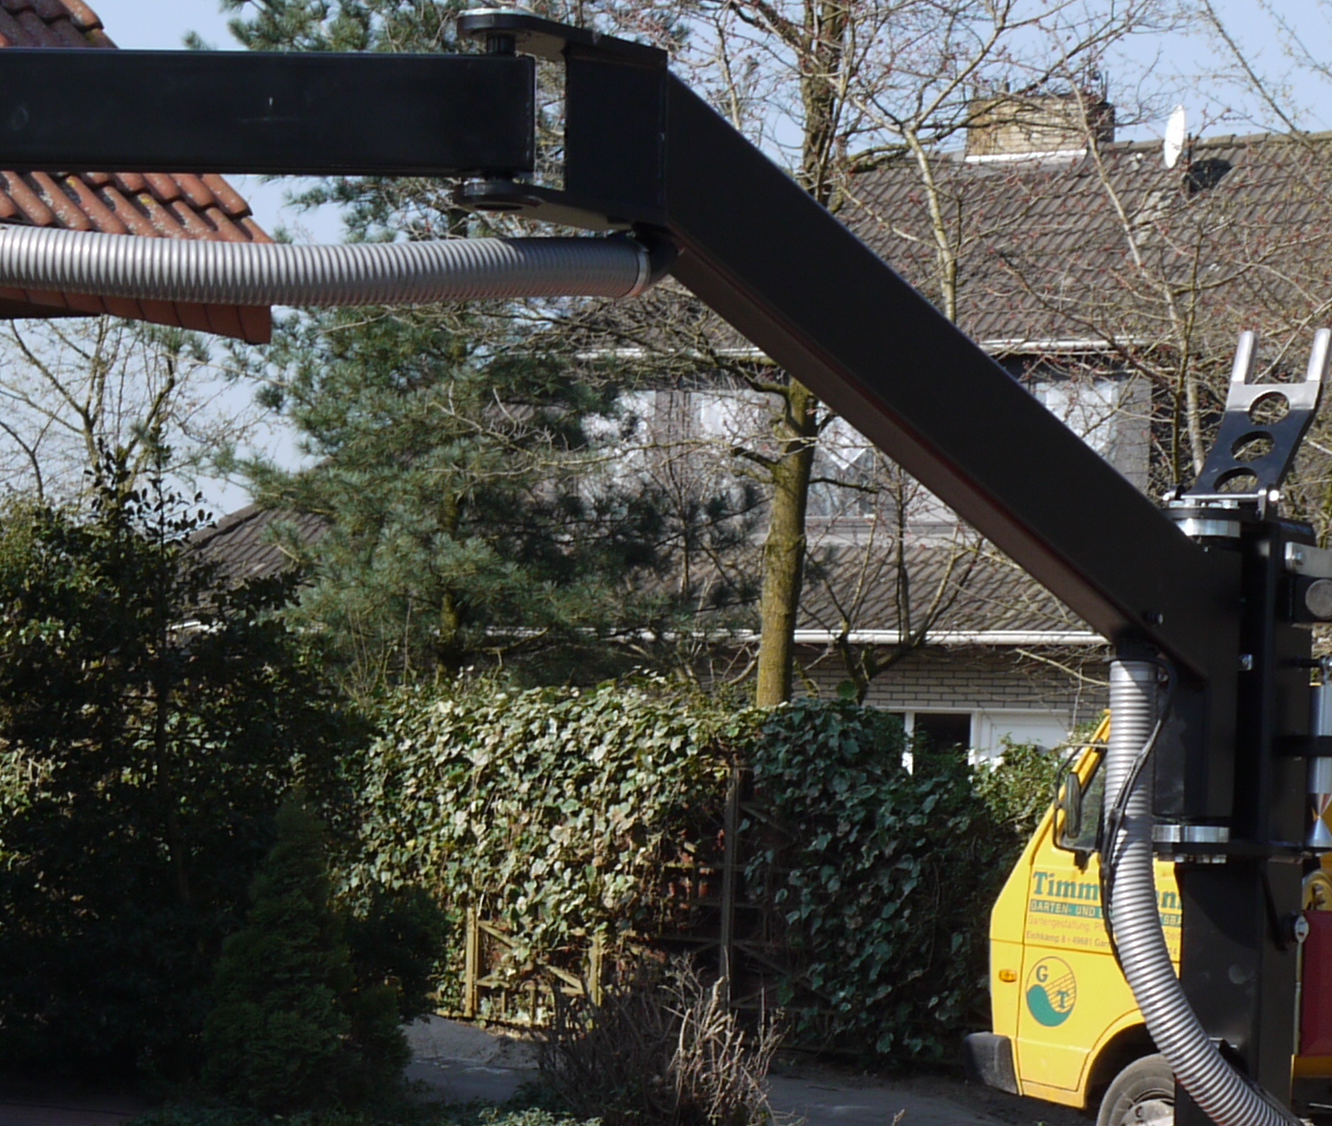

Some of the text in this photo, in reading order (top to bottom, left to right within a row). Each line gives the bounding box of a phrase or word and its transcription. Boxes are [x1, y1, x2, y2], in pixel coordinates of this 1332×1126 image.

[1076, 905, 1096, 917] UND
[1036, 965, 1048, 983] G
[1057, 991, 1070, 1009] T
